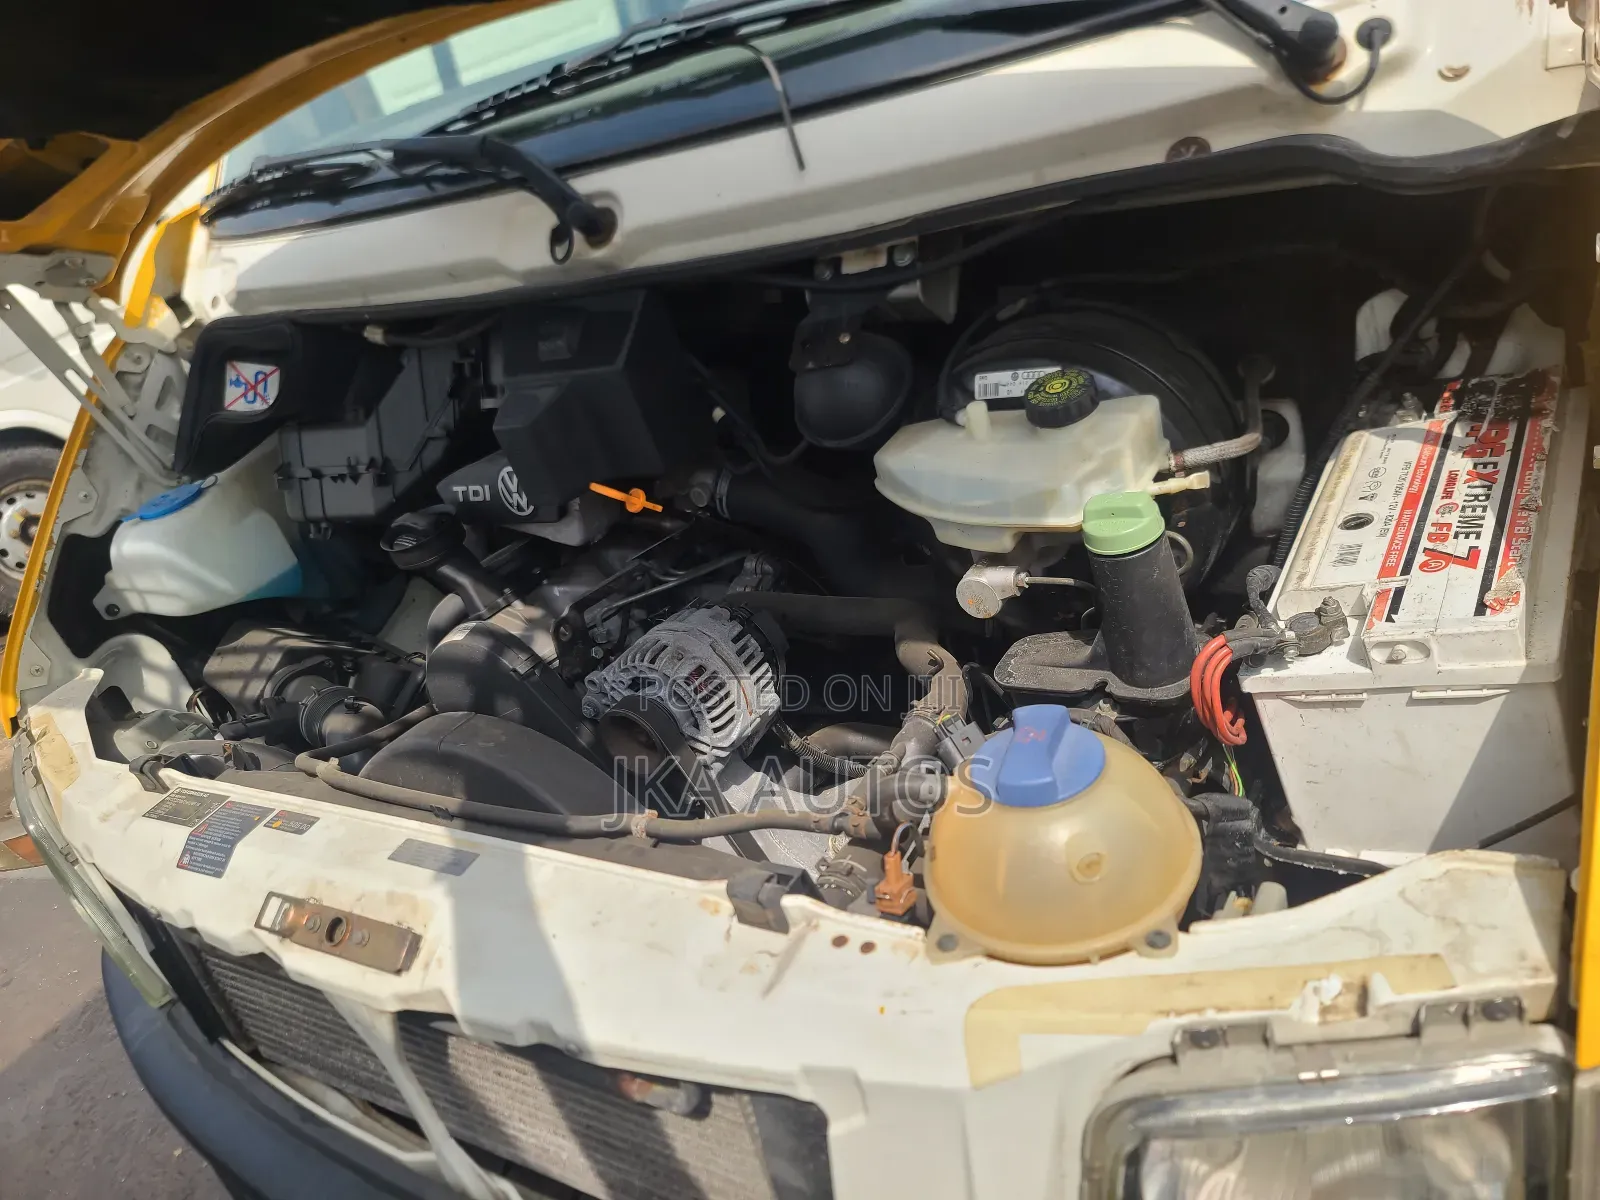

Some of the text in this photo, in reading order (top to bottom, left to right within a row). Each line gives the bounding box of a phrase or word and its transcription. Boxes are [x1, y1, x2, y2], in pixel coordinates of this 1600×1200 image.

[453, 484, 491, 503] TDI
[1408, 464, 1428, 494] Technology
[1453, 461, 1500, 541] EXTREME
[1391, 509, 1413, 550] MAINTENANCE
[1386, 551, 1399, 568] FREE
